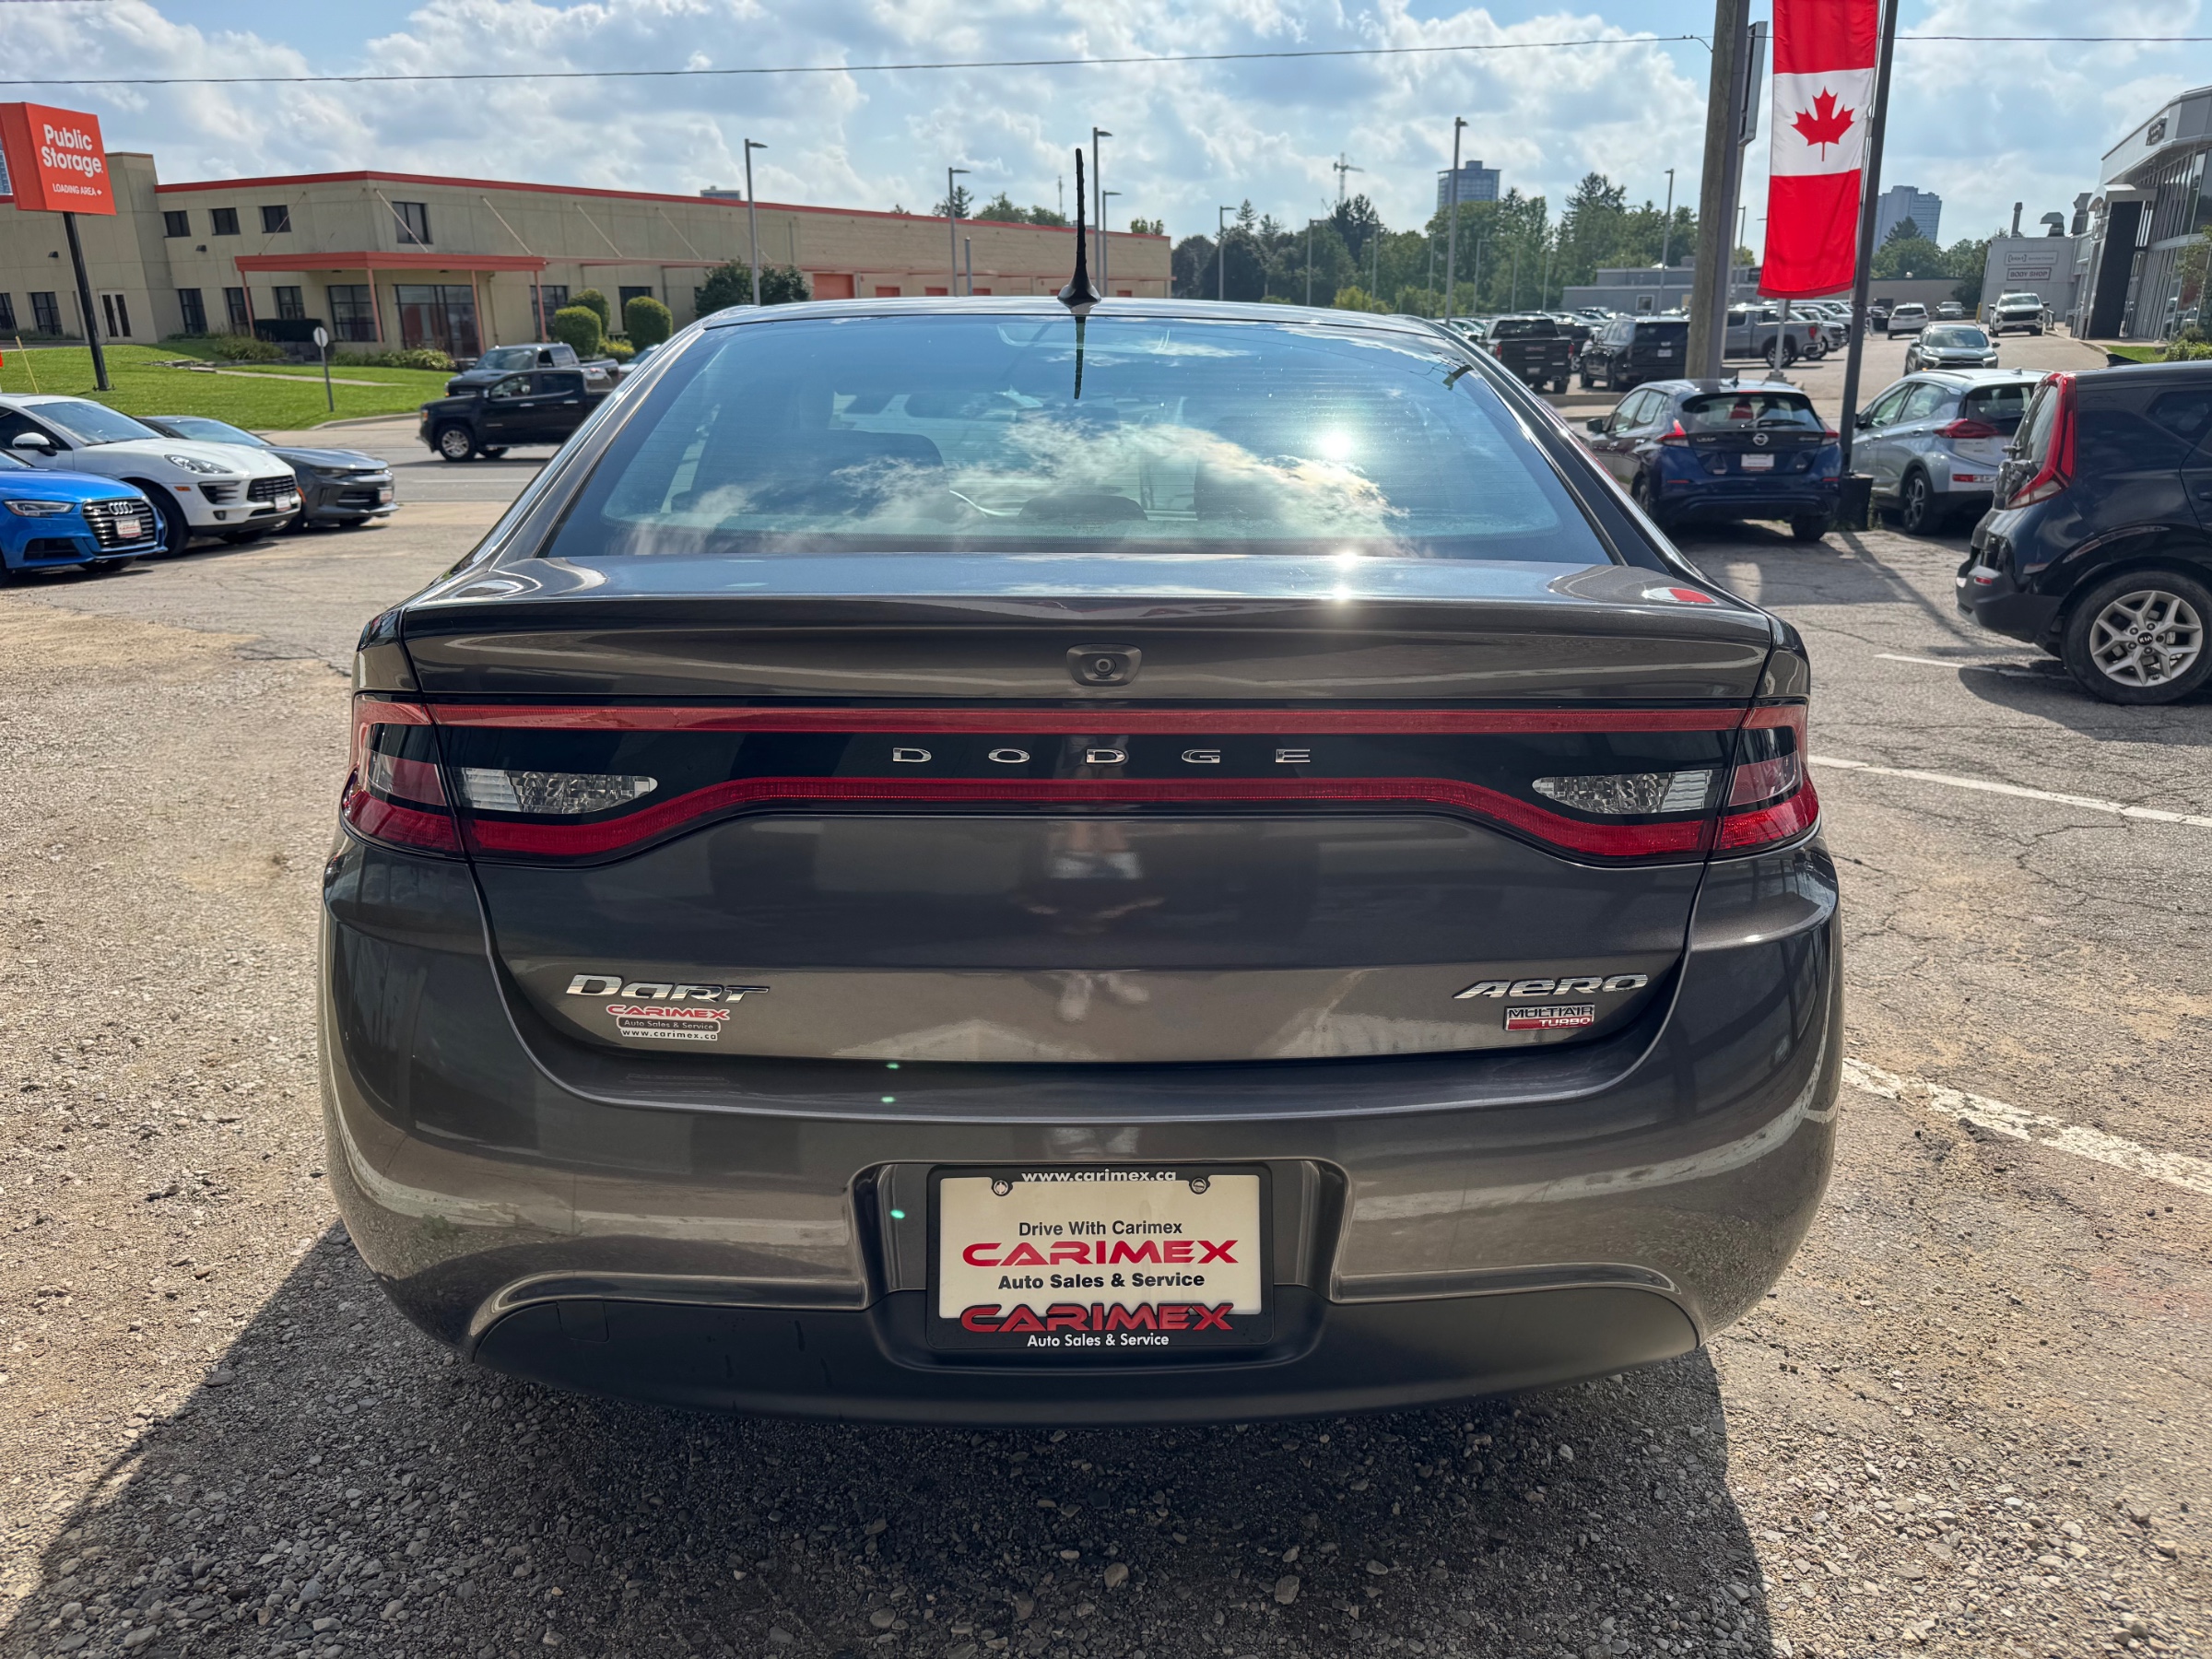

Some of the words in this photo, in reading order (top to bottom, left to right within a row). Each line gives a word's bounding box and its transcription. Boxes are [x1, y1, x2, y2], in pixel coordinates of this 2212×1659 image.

[43, 124, 92, 151] Public
[41, 146, 101, 178] Storage
[53, 182, 79, 194] LOADING
[80, 186, 97, 196] AREA
[892, 747, 1312, 764] DODGE
[607, 1006, 729, 1019] CARIMEX
[1508, 1006, 1594, 1018] MULTIAIR
[682, 1022, 714, 1030] Service
[1538, 1017, 1592, 1028] TURBO
[621, 1029, 717, 1040] www.carimex.ca
[1020, 1168, 1177, 1182] www.carimex.ca
[1018, 1222, 1064, 1236] Drive
[1068, 1221, 1107, 1235] With
[1112, 1220, 1182, 1235] Carimex
[962, 1240, 1239, 1267] CARIMEX
[998, 1275, 1044, 1289] Auto
[1050, 1274, 1105, 1288] Sales
[1111, 1273, 1126, 1288] &
[1132, 1272, 1206, 1288] Service
[960, 1304, 1234, 1333] CARIMEX
[1027, 1335, 1061, 1347] Auto
[1065, 1334, 1101, 1347] Sales
[1105, 1334, 1116, 1346] &
[1120, 1333, 1170, 1346] Service
